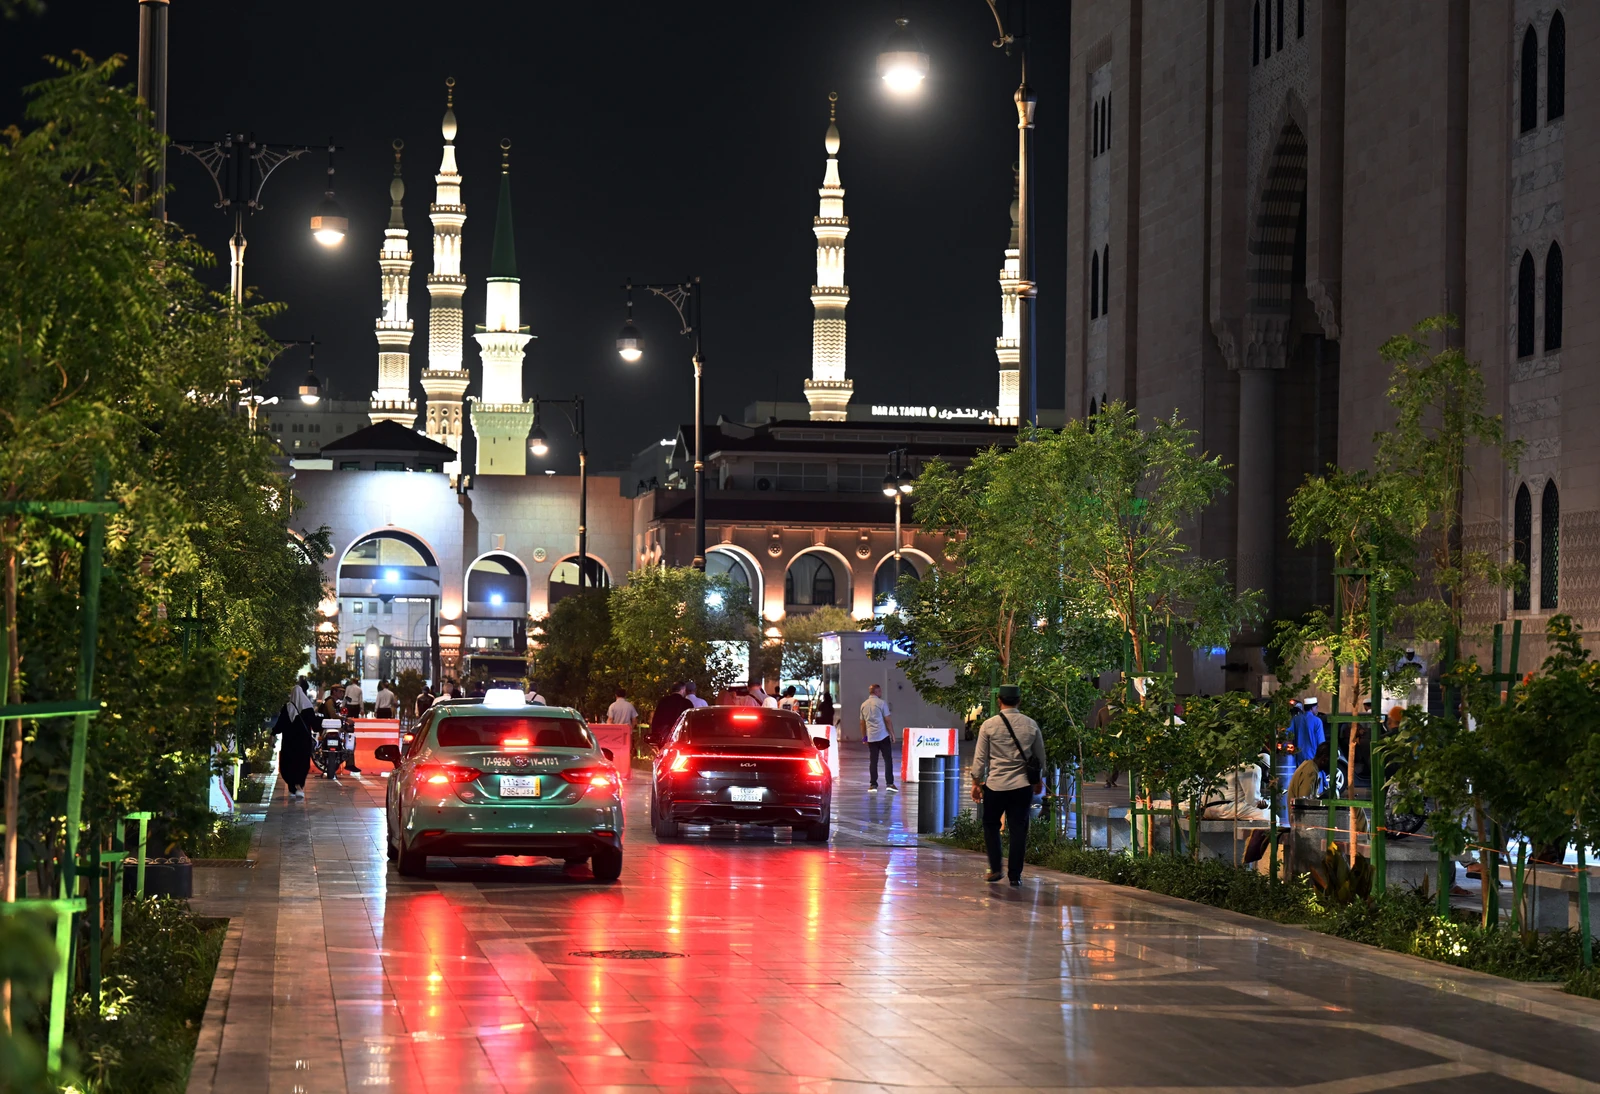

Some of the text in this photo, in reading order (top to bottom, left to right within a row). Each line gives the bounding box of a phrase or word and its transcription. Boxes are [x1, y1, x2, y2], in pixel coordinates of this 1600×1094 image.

[872, 406, 928, 417] DAR AL TAQWA
[938, 408, 978, 420] التقوى
[864, 641, 891, 651] Mobily
[482, 757, 511, 767] 17-9256
[502, 787, 519, 796] 7964
